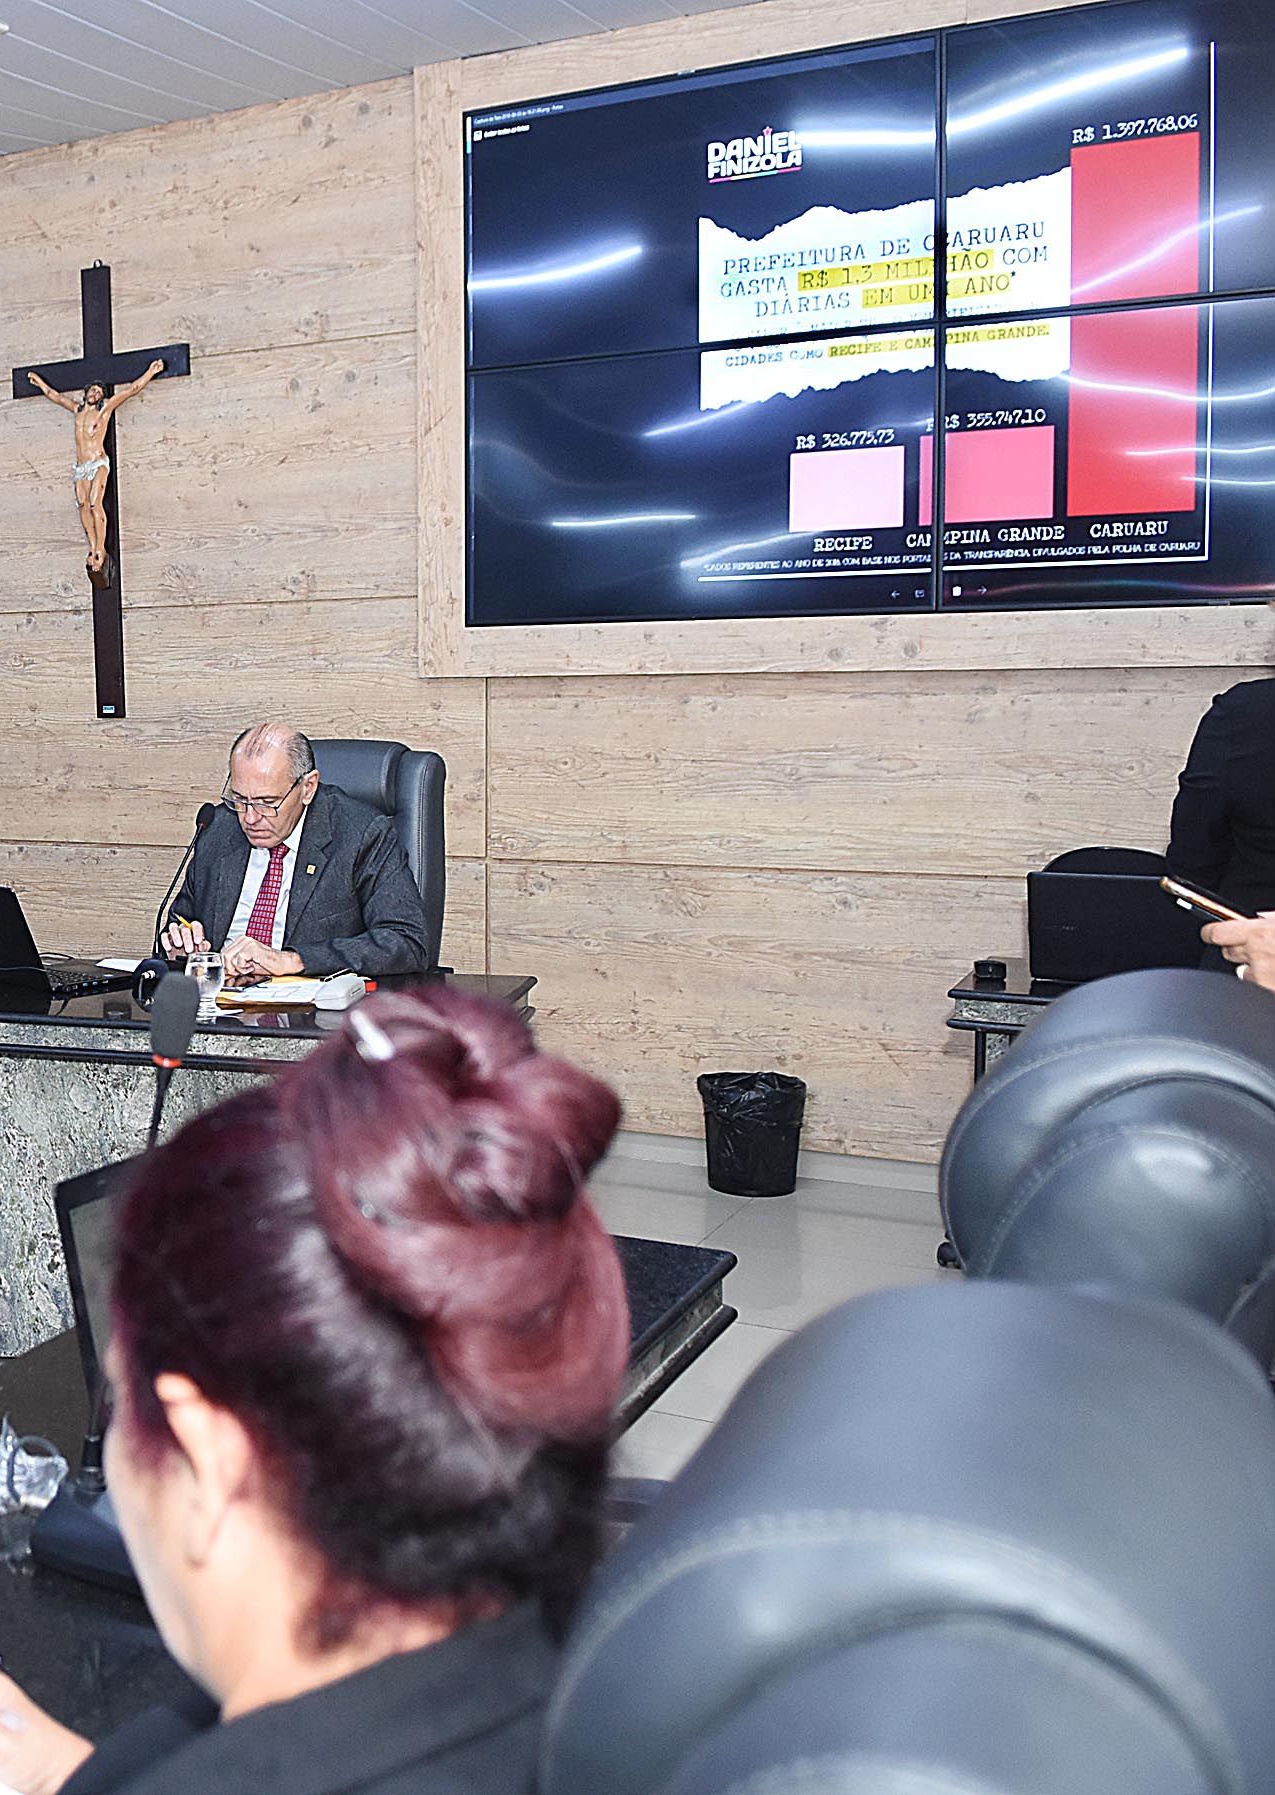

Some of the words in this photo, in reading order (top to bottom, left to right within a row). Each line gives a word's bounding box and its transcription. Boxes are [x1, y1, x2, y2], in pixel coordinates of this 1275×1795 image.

[1071, 126, 1095, 144] R$
[1102, 113, 1198, 140] 1.397.768,06
[707, 128, 802, 162] DANIEL
[707, 149, 802, 179] FINIZOLA
[720, 276, 788, 298] GASTA
[802, 269, 829, 289] R$
[842, 264, 873, 286] 1,3
[1003, 245, 1048, 266] COM
[723, 243, 866, 275] PREFEITURA
[880, 238, 911, 257] DE
[755, 292, 851, 317] DIÁRIAS
[864, 287, 893, 306] EM
[725, 351, 783, 367] CIDADES
[830, 342, 882, 357] RECIFE
[889, 341, 898, 351] E
[987, 324, 1050, 341] GRANDE.
[796, 434, 816, 450] R$
[822, 428, 895, 448] 326.775,73
[813, 536, 873, 552] RECIFE
[997, 525, 1066, 542] GRANDE
[1089, 520, 1169, 539] CARUARU
[1144, 543, 1158, 553] DE
